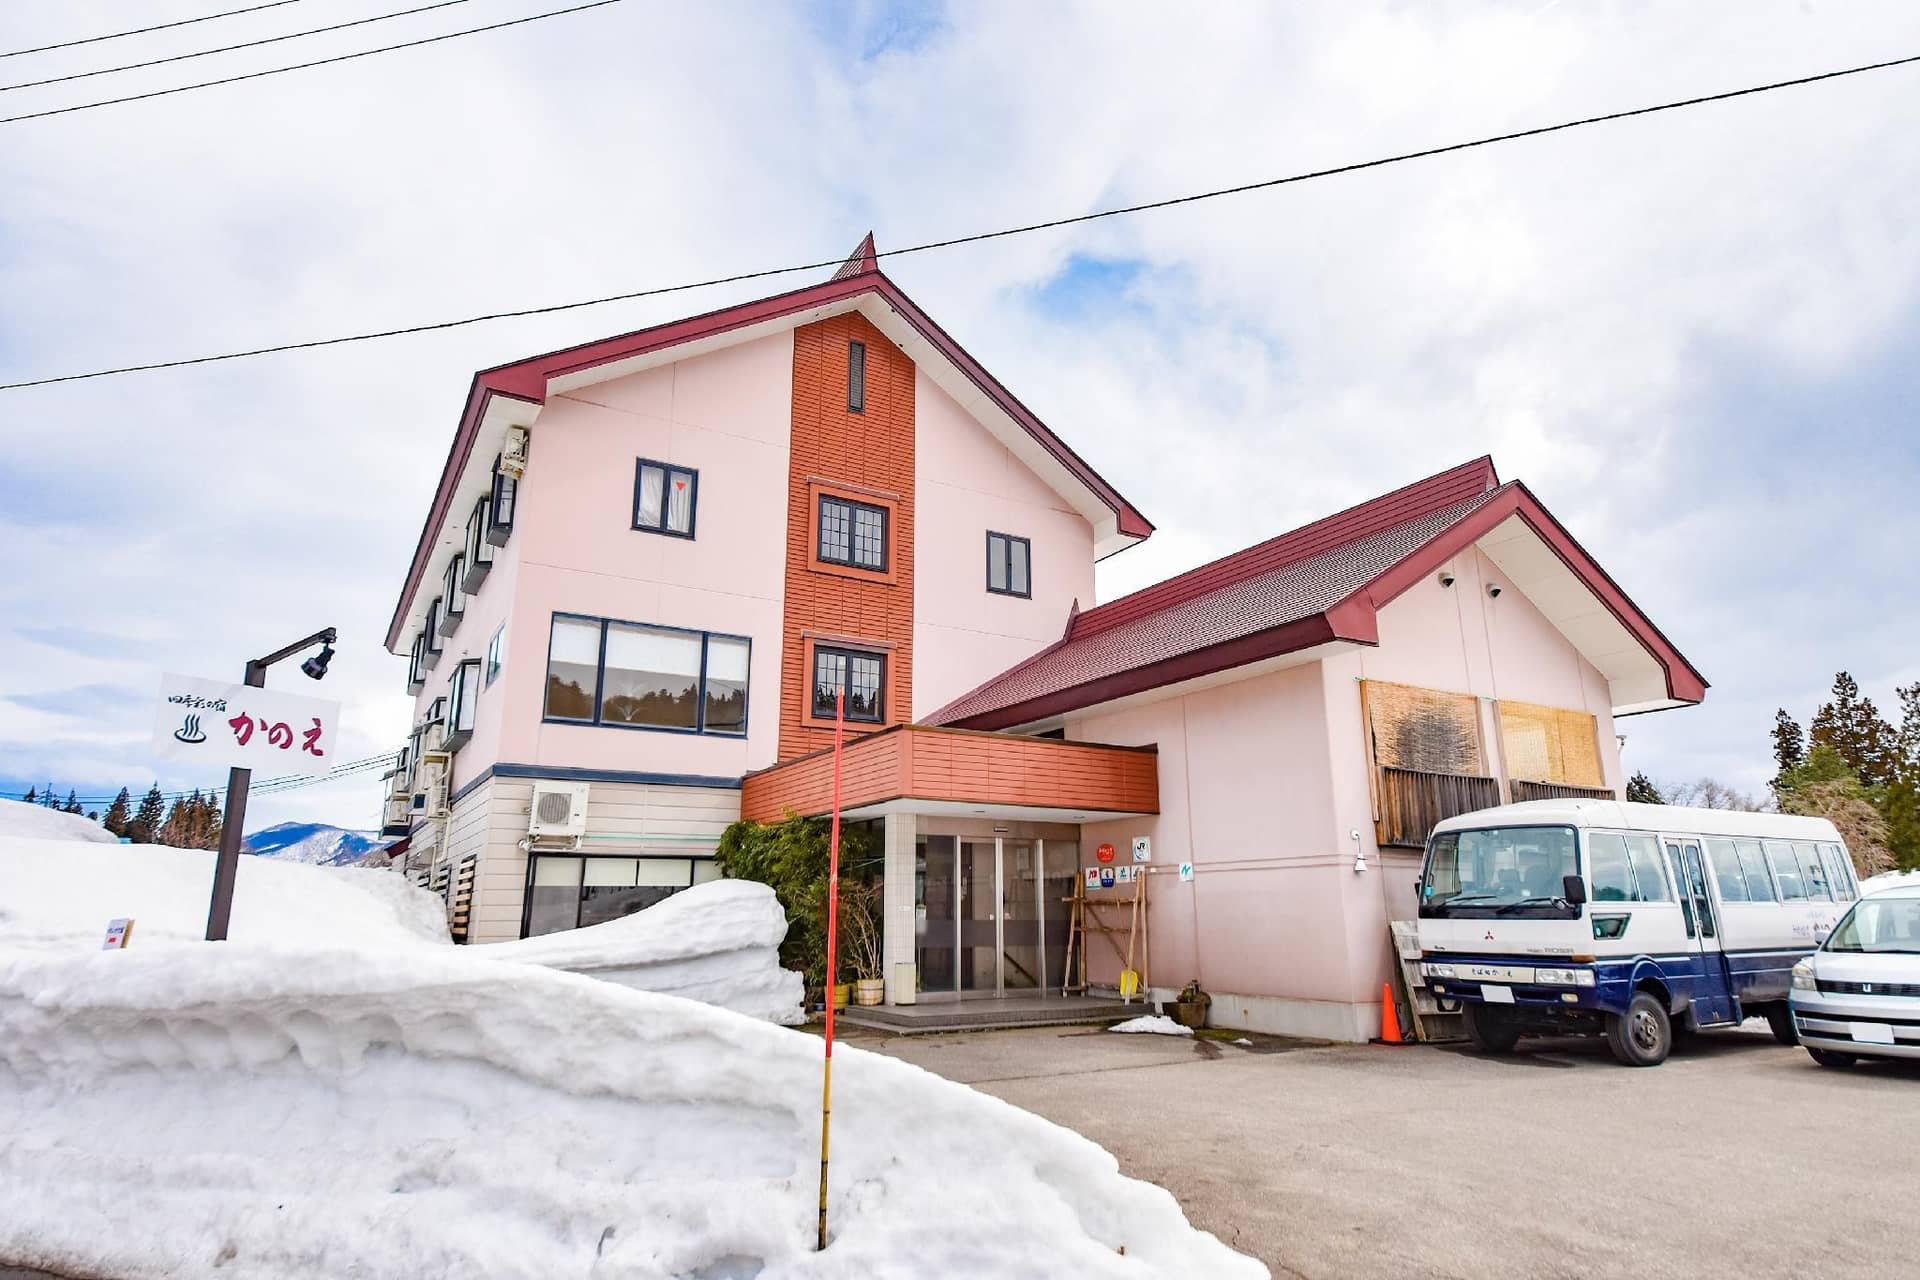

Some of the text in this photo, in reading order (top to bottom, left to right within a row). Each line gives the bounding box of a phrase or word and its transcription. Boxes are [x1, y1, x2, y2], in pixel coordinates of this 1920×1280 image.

[228, 711, 324, 756] かのえ
[1136, 842, 1146, 850] JR
